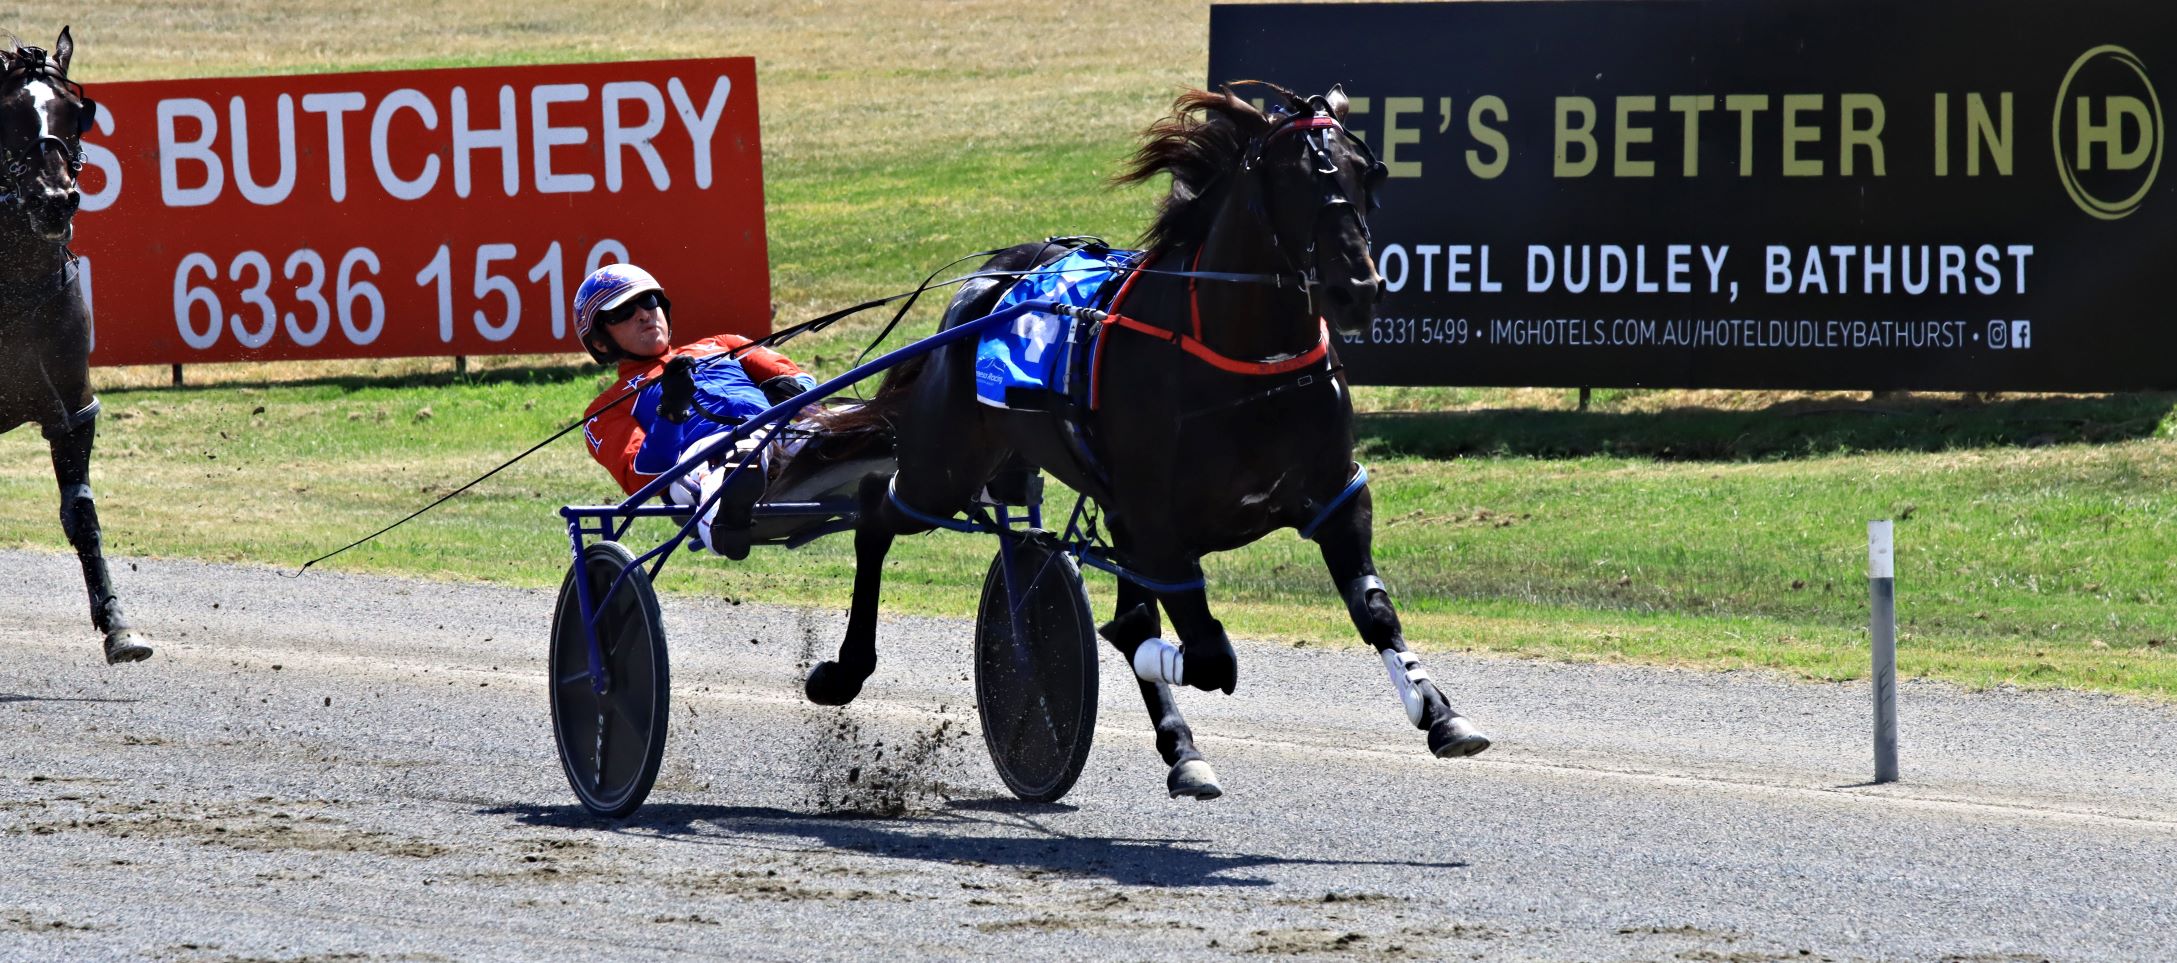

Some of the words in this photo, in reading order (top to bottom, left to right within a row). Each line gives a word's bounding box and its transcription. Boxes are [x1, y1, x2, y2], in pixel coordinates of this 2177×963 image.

[156, 75, 731, 207] BUTCHERY
[1554, 93, 1885, 178] BETTER
[1935, 92, 2014, 177] IN
[2077, 96, 2154, 170] HD
[174, 247, 386, 350] 6336
[1378, 243, 1503, 293] OTEL
[1528, 244, 1739, 303] DUDLEY,
[1766, 244, 2034, 294] BATHURST
[1371, 318, 1415, 344] 6331
[1422, 318, 1468, 344] 5499
[1490, 319, 1967, 348] IMGHOTELS.COM.AU/HOTELDUDLEYBATHURST
